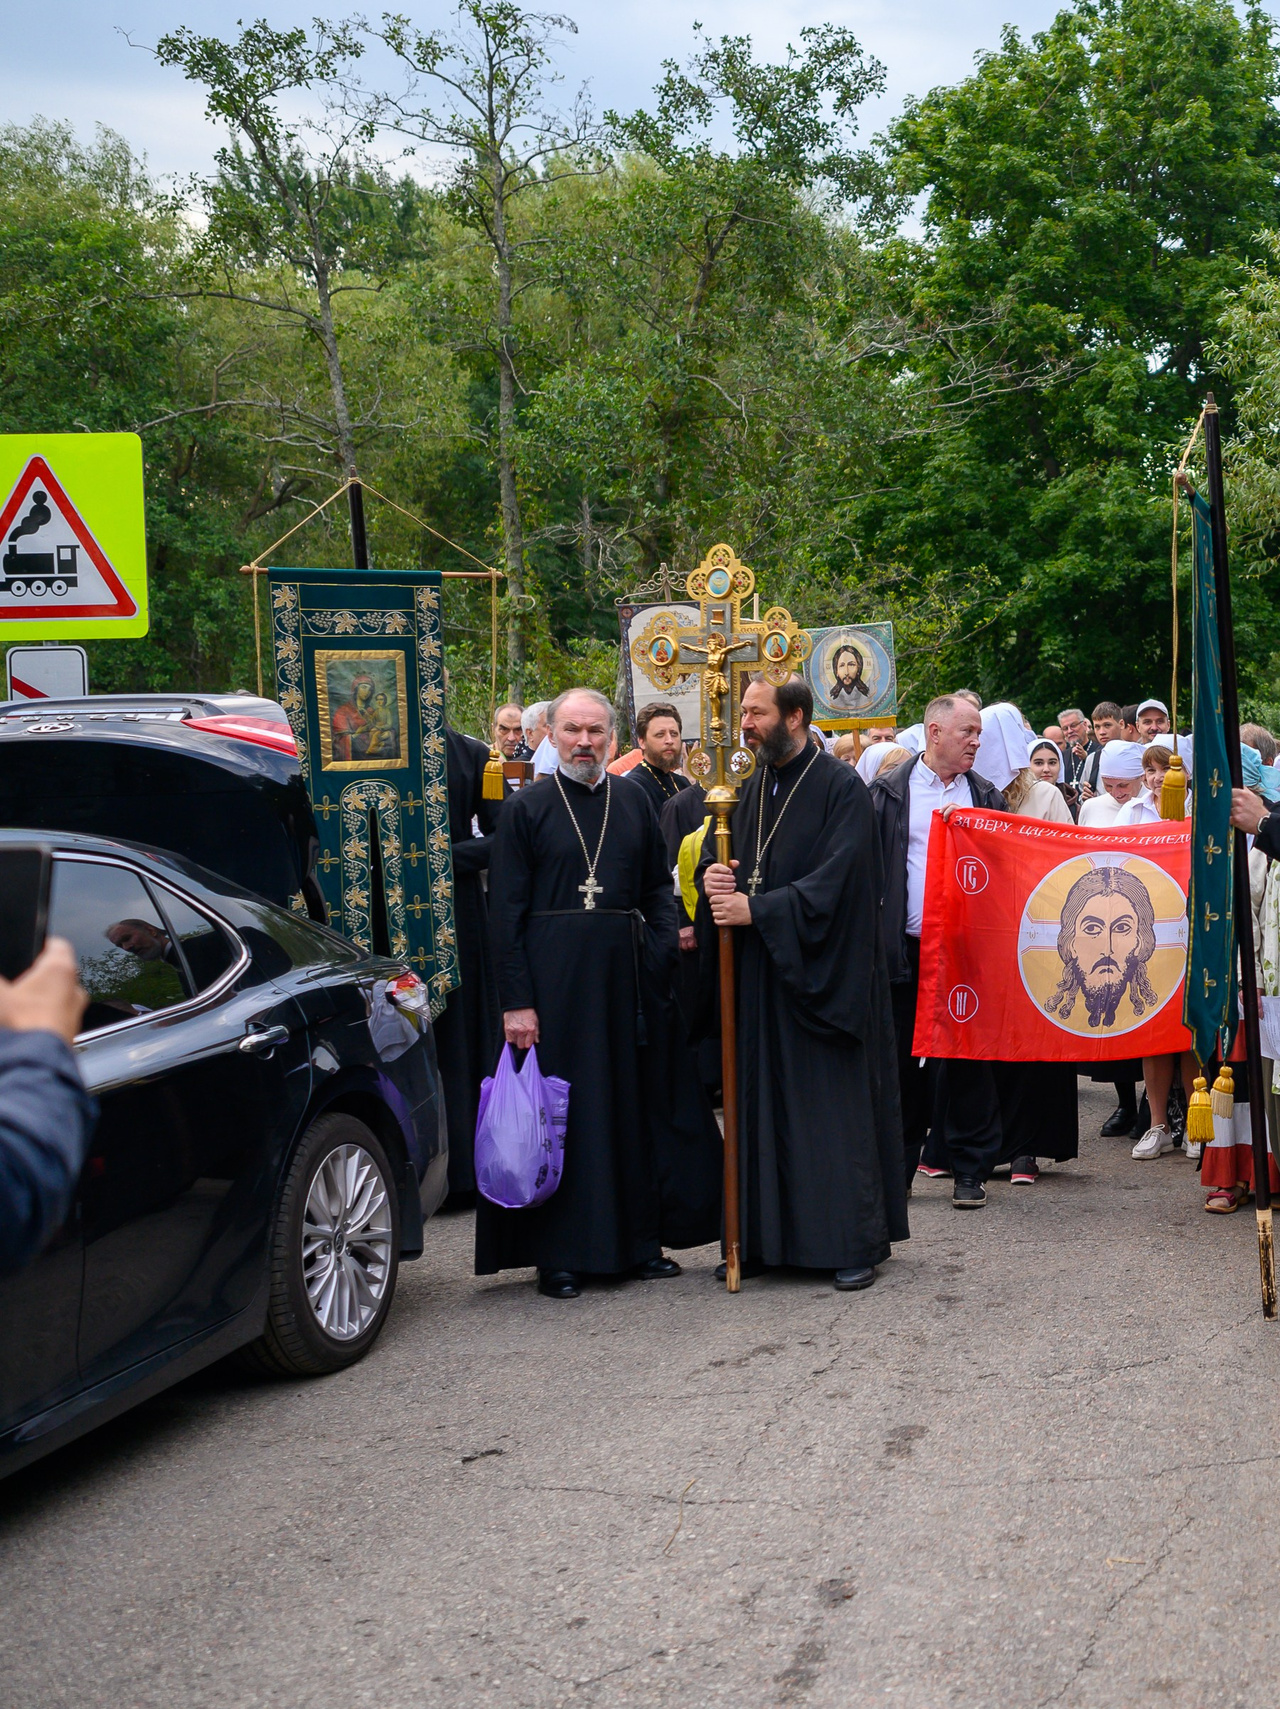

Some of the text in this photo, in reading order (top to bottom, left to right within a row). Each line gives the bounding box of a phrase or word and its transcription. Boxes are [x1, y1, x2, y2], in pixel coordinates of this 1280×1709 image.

[953, 815, 971, 828] ЗА
[973, 818, 1013, 833] ВЕРУ,
[1019, 825, 1060, 838] ЦАРЯ
[1075, 834, 1137, 844] СВЯТУЮ
